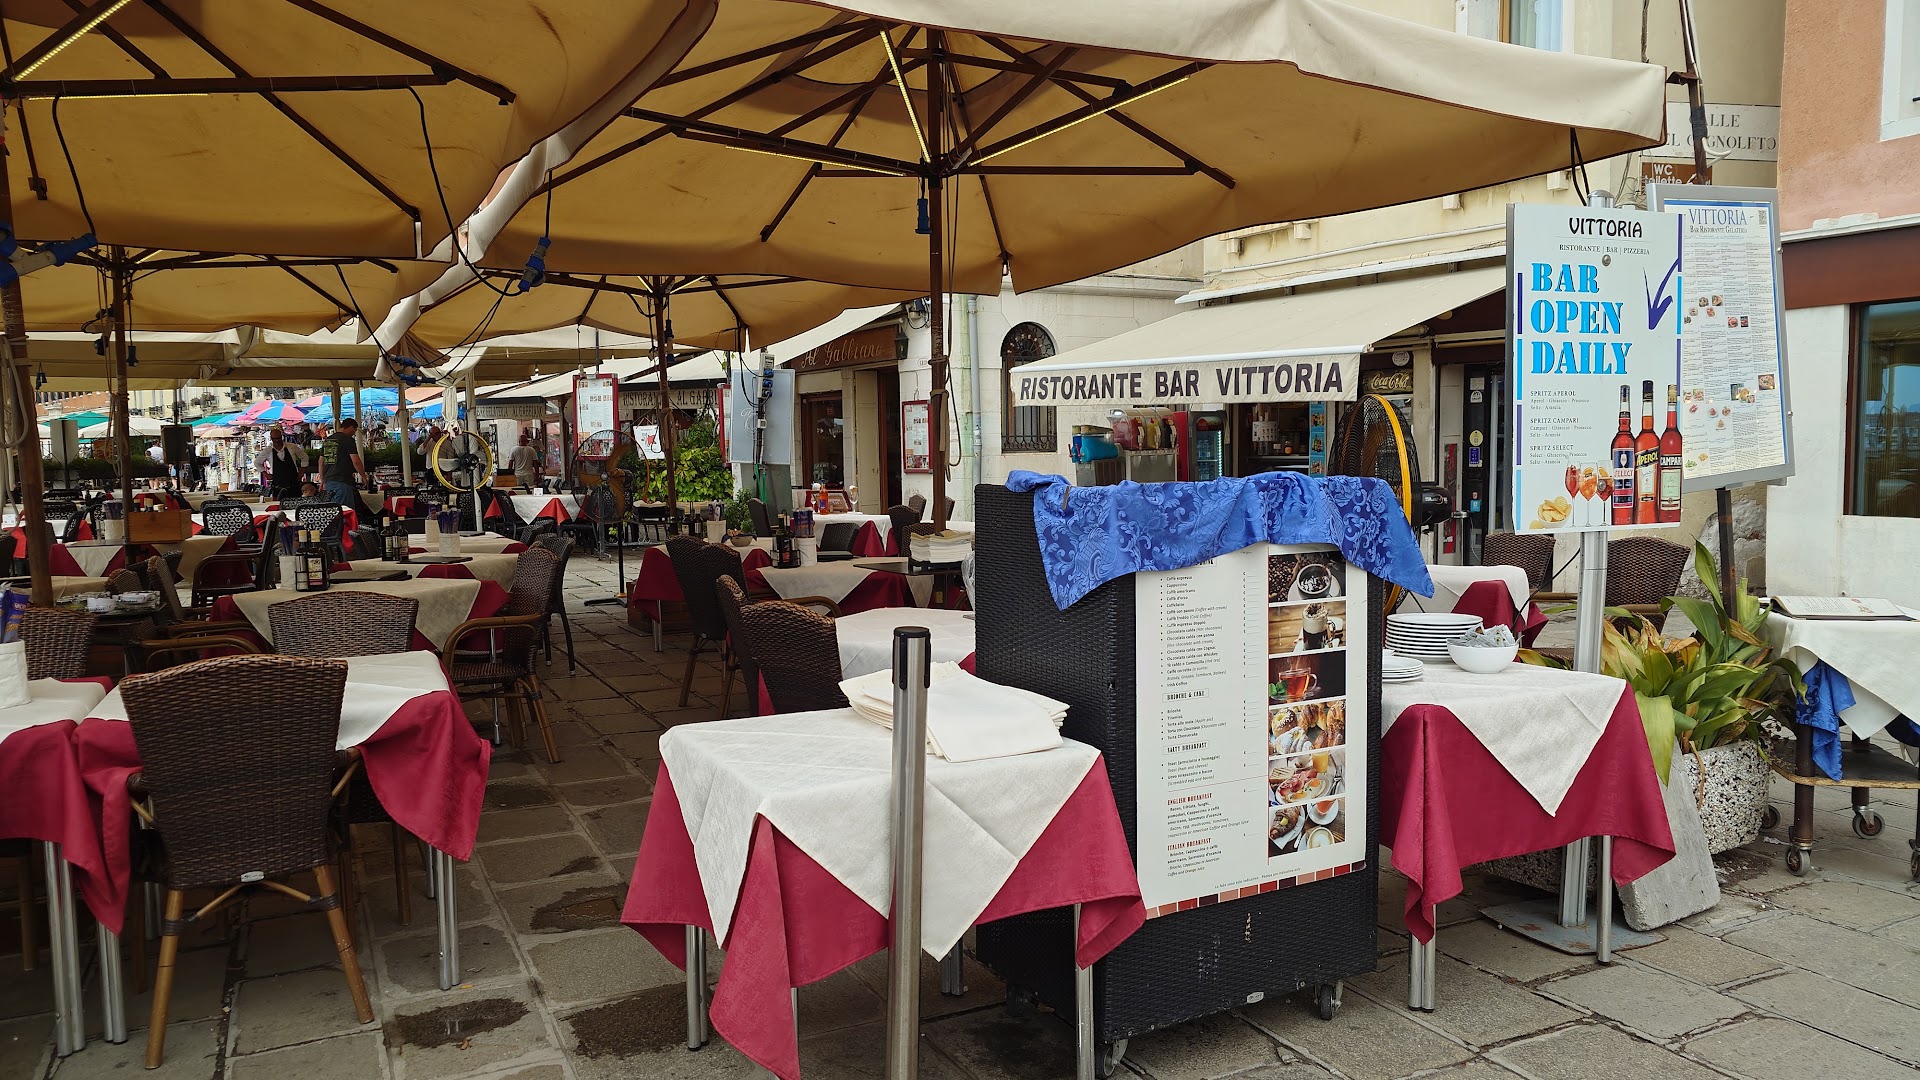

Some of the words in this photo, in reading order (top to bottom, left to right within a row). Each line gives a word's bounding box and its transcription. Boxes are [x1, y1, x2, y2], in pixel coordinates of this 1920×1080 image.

[1710, 114, 1740, 128] LLE
[1667, 134, 1680, 146] EL
[1686, 136, 1776, 150] CGNOLETO
[1654, 164, 1673, 175] WC
[1689, 208, 1747, 225] VITTORIA
[1569, 218, 1642, 238] VITTORIA
[1559, 244, 1601, 253] RISTORANTE
[1531, 263, 1600, 293] BAR
[1531, 300, 1624, 334] OPEN
[1531, 342, 1633, 374] DAILY
[1020, 372, 1142, 400] RISTORANTE
[1156, 370, 1199, 397] BAR
[1216, 362, 1342, 396] VITTORIA
[677, 392, 688, 405] AL
[1637, 451, 1658, 466] APEROL
[1182, 742, 1207, 751] BREAKFAST
[1187, 793, 1212, 802] BREAKFAST
[1186, 838, 1212, 847] BREAKFAST
